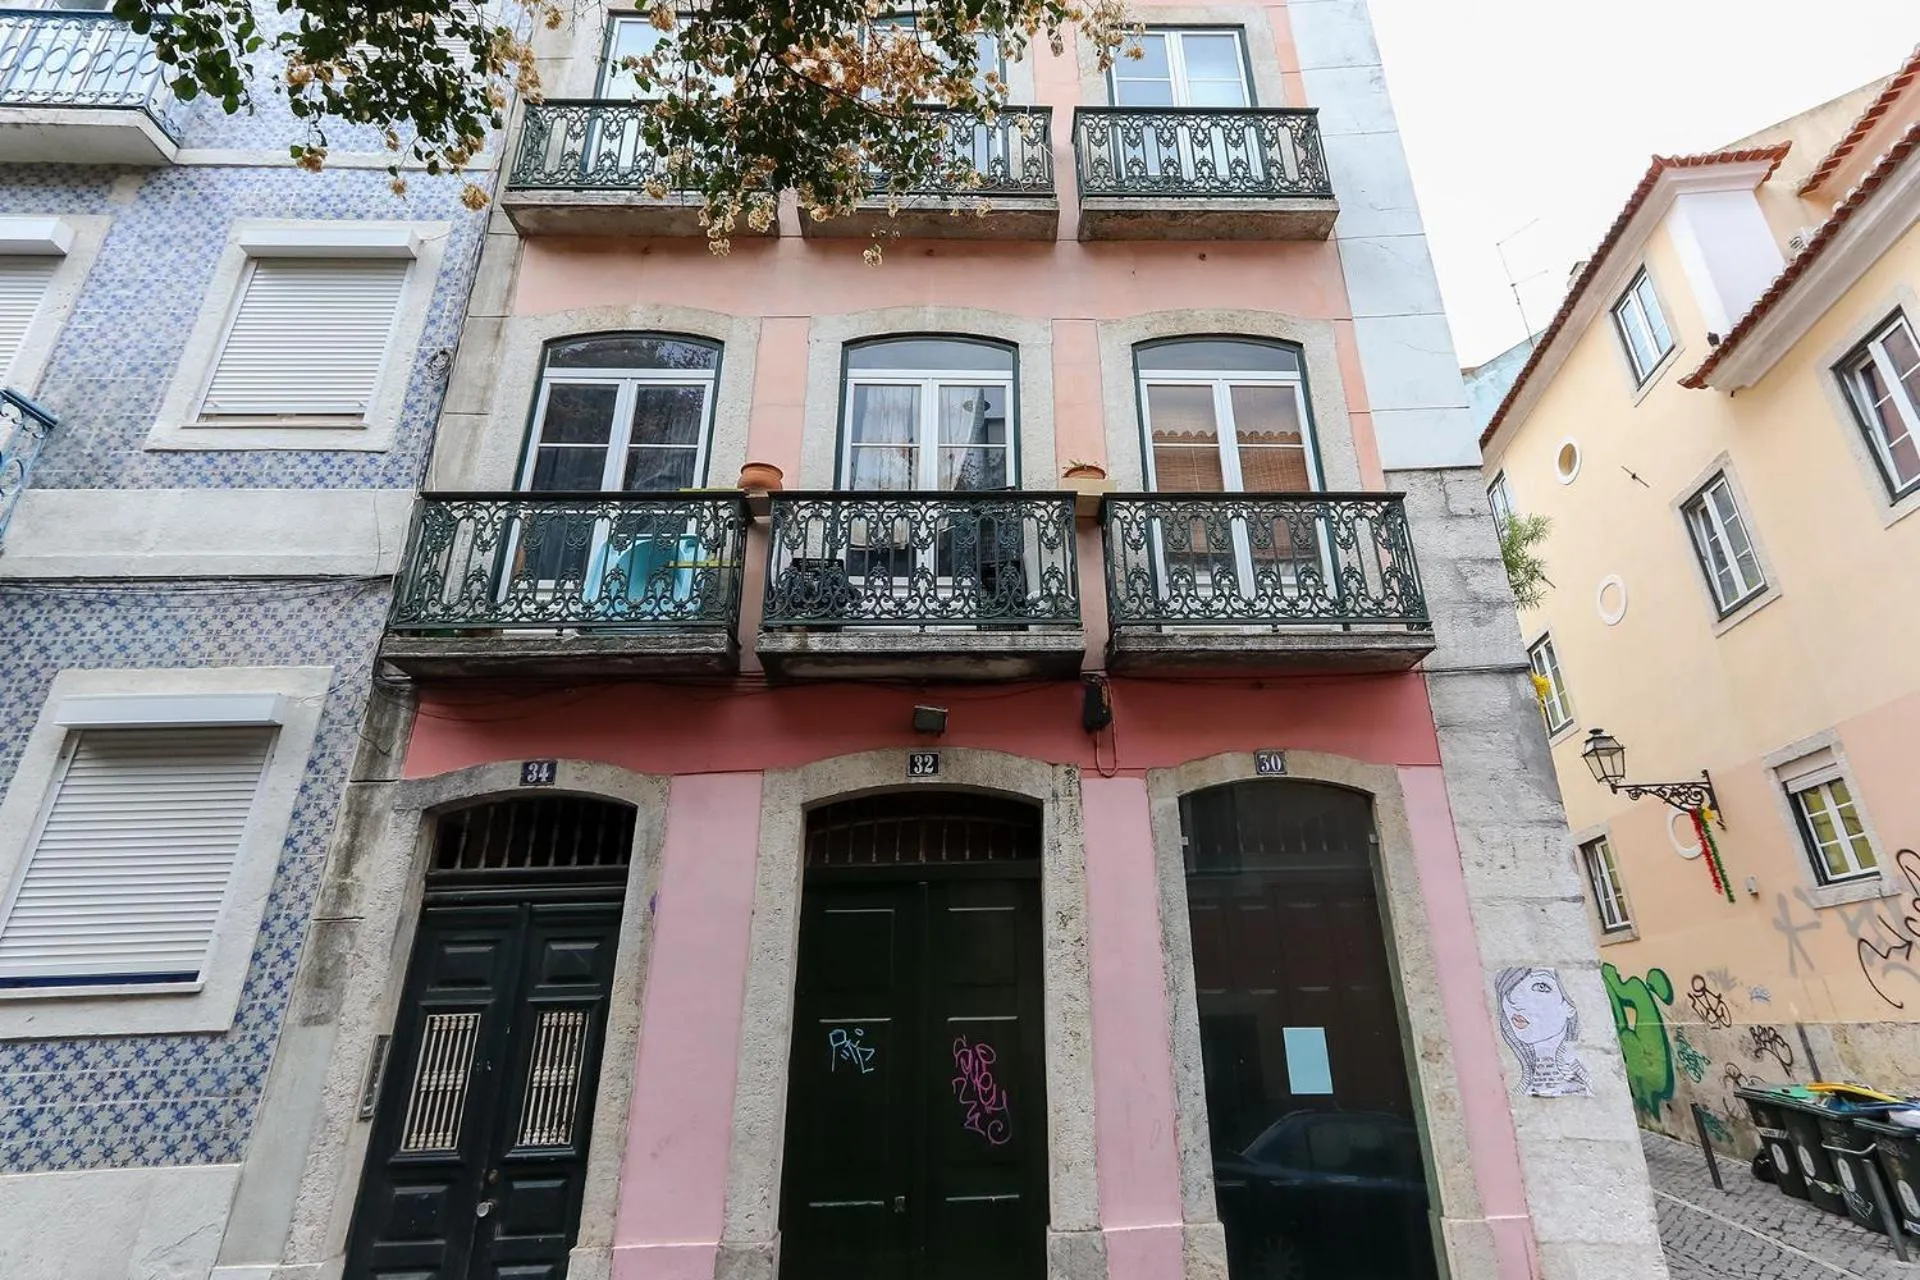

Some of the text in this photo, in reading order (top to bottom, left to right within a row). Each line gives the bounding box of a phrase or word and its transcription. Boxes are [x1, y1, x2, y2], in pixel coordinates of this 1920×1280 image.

[527, 763, 550, 782] 34
[914, 755, 934, 774] 32
[1259, 754, 1281, 772] 30
